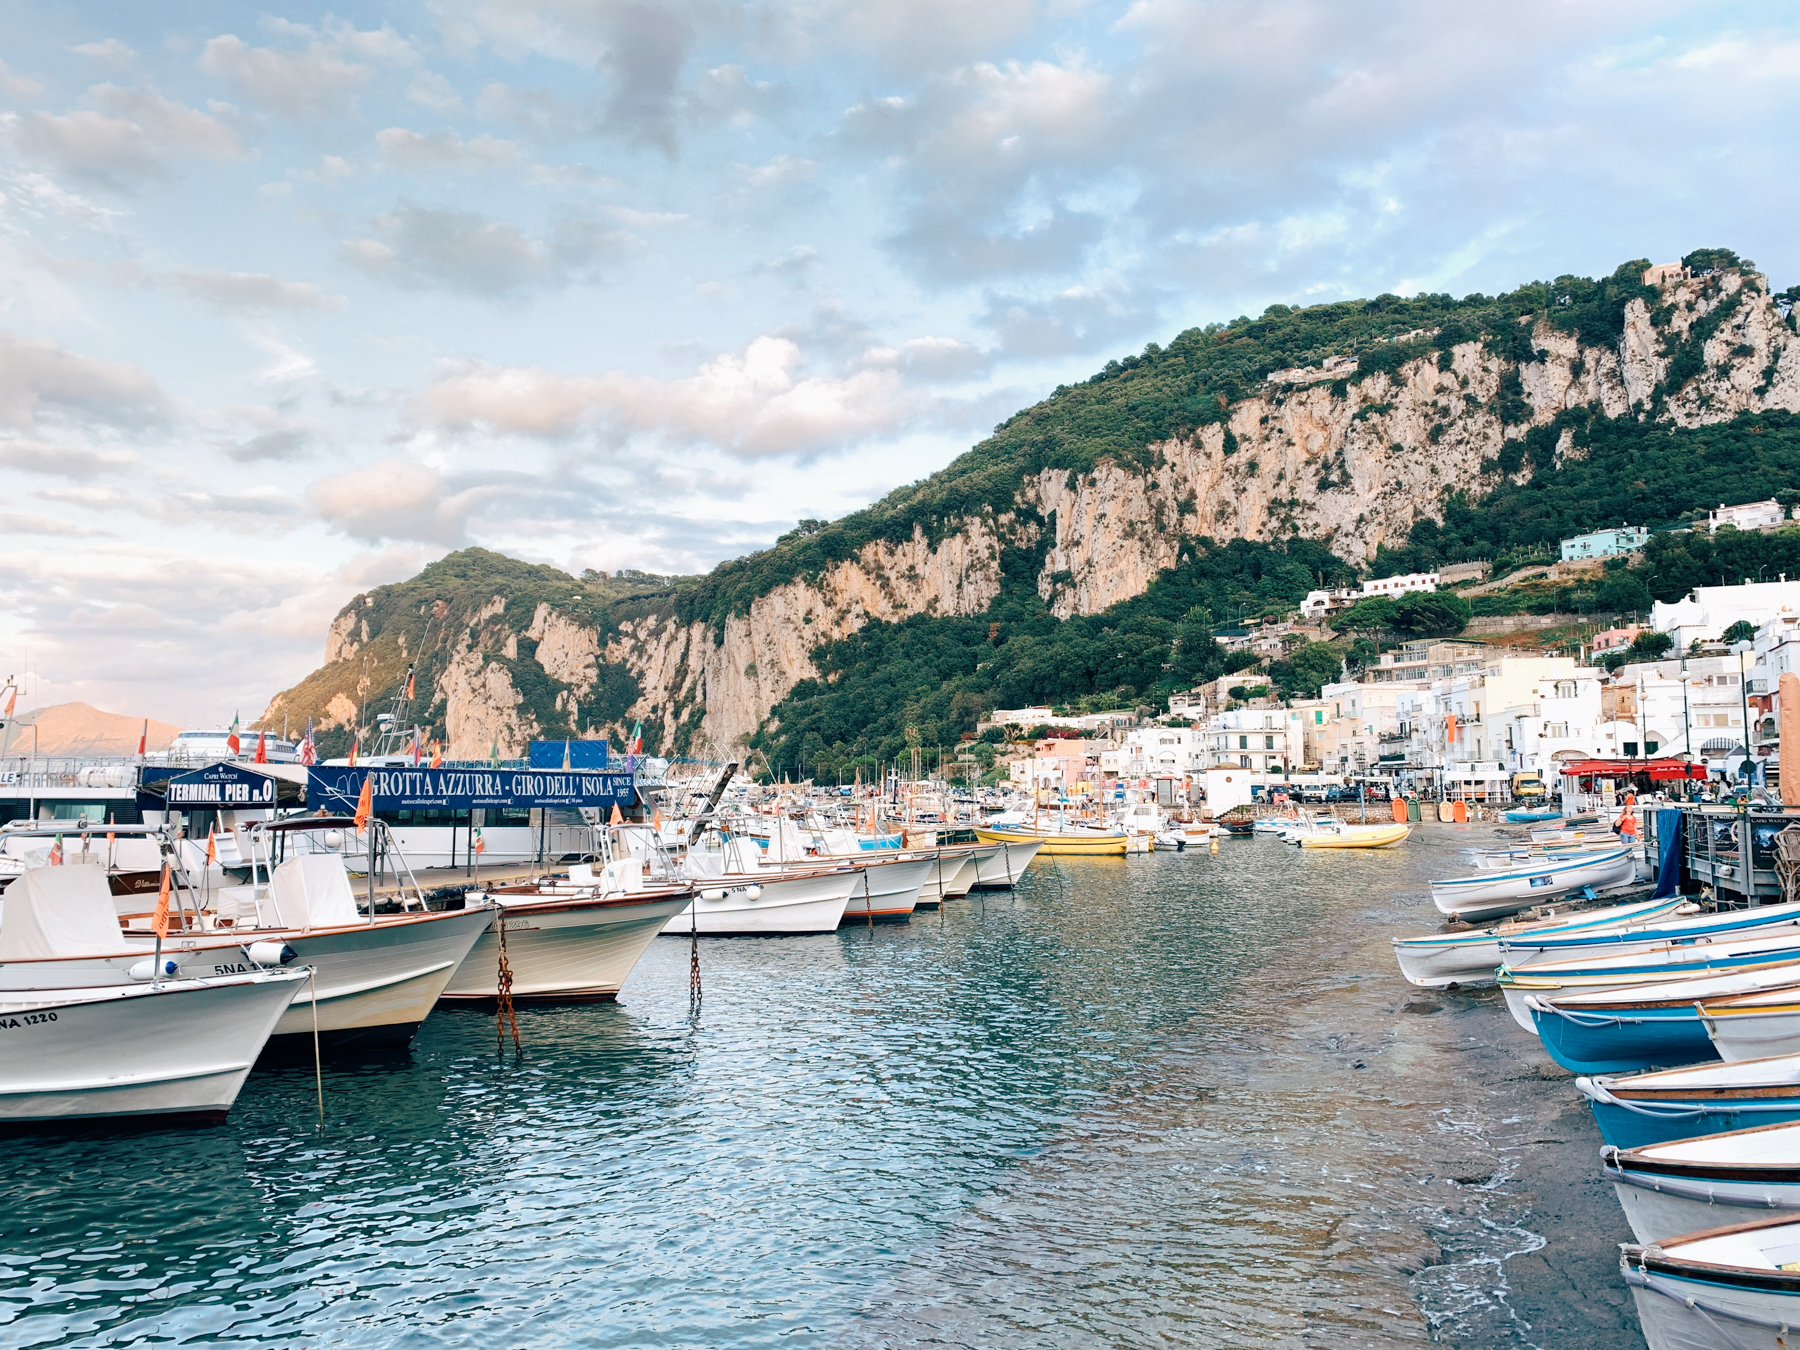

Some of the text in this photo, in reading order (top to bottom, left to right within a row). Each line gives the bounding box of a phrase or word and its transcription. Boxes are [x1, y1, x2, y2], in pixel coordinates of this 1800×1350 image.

[371, 772, 434, 796] GROTTA
[437, 772, 502, 796] AZZURRA
[512, 774, 544, 796] GIRO
[546, 776, 579, 796] DELL'
[582, 776, 614, 796] ISOLA
[613, 776, 632, 786] SINCE
[170, 784, 222, 801] TERMINAL
[225, 784, 250, 801] PIER
[617, 788, 630, 798] 1955
[23, 1012, 58, 1025] 1220
